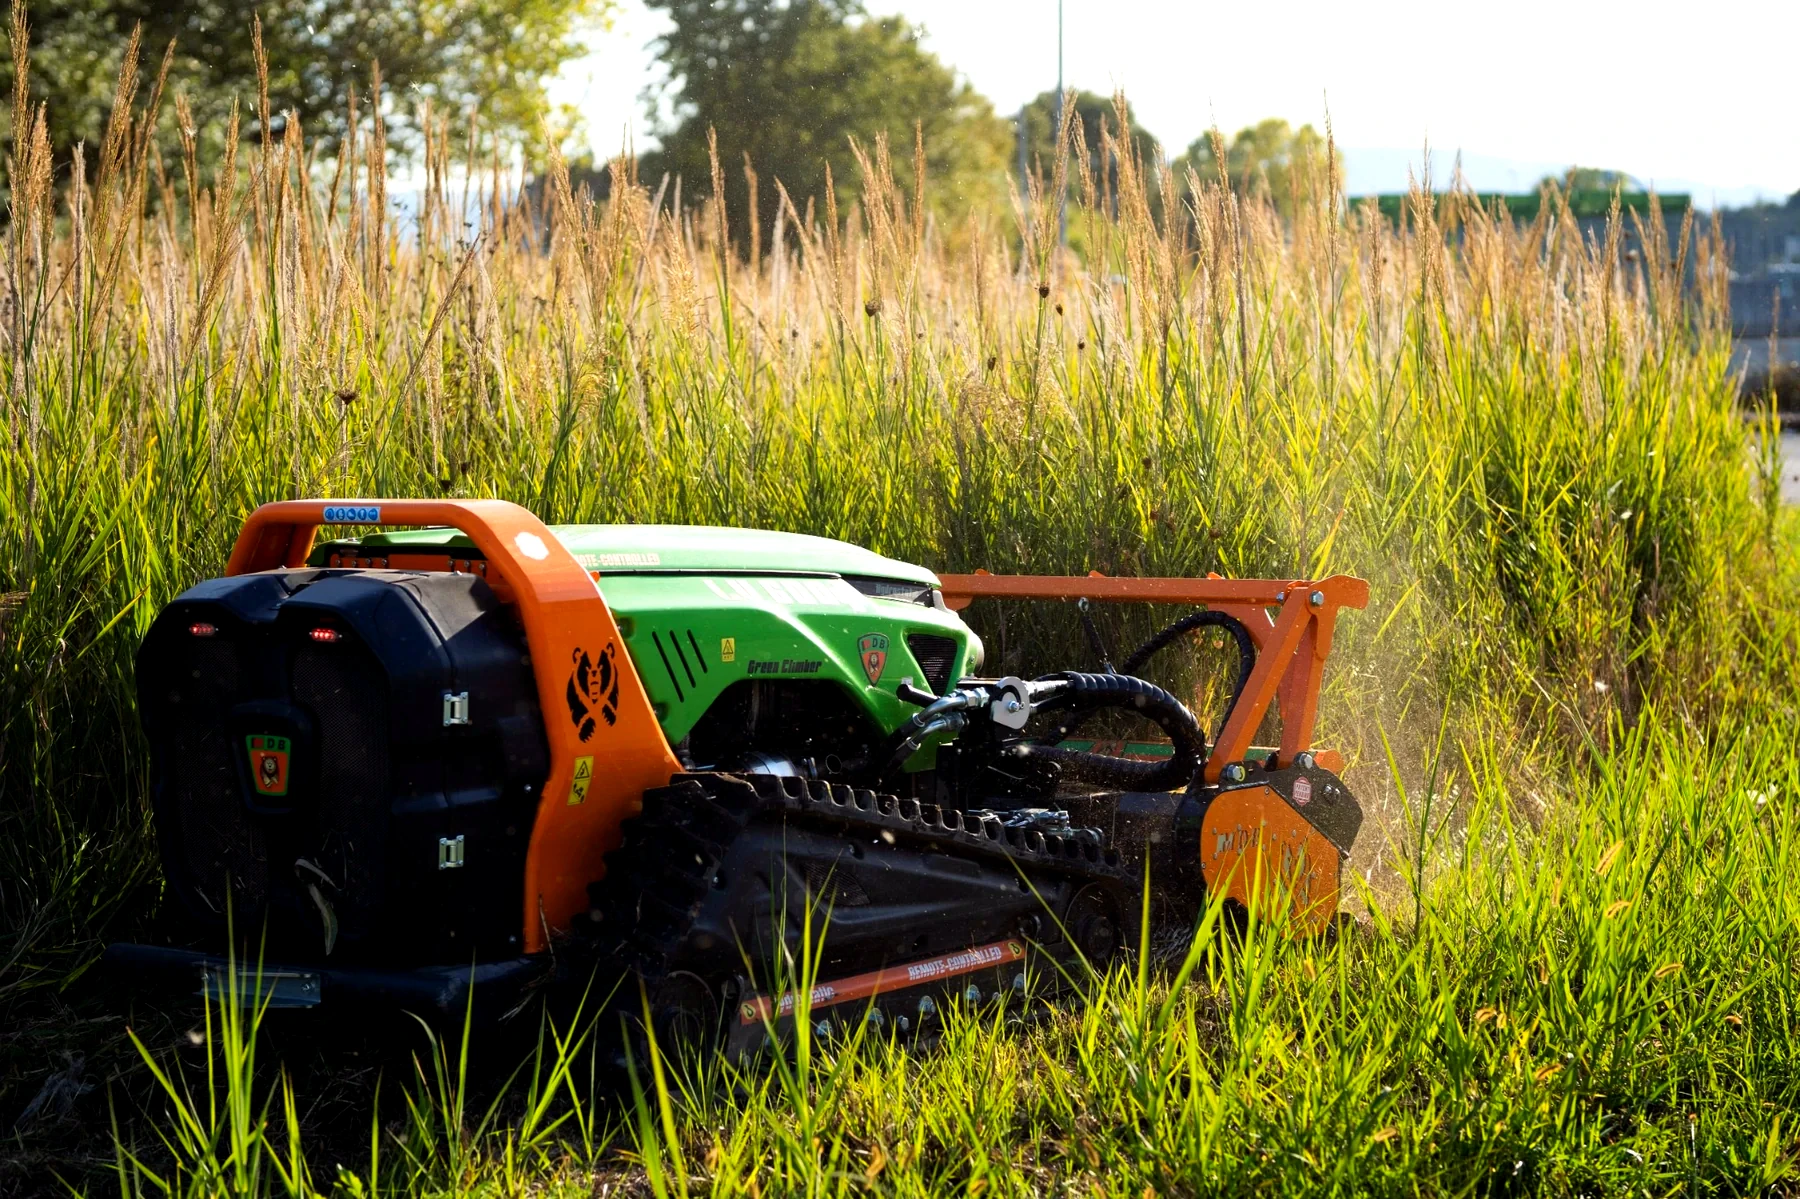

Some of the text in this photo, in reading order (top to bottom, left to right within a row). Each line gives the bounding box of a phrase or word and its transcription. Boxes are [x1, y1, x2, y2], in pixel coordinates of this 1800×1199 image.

[747, 659, 823, 674] Green Climber
[907, 946, 1002, 980] REMOTE-CONTROLLED
